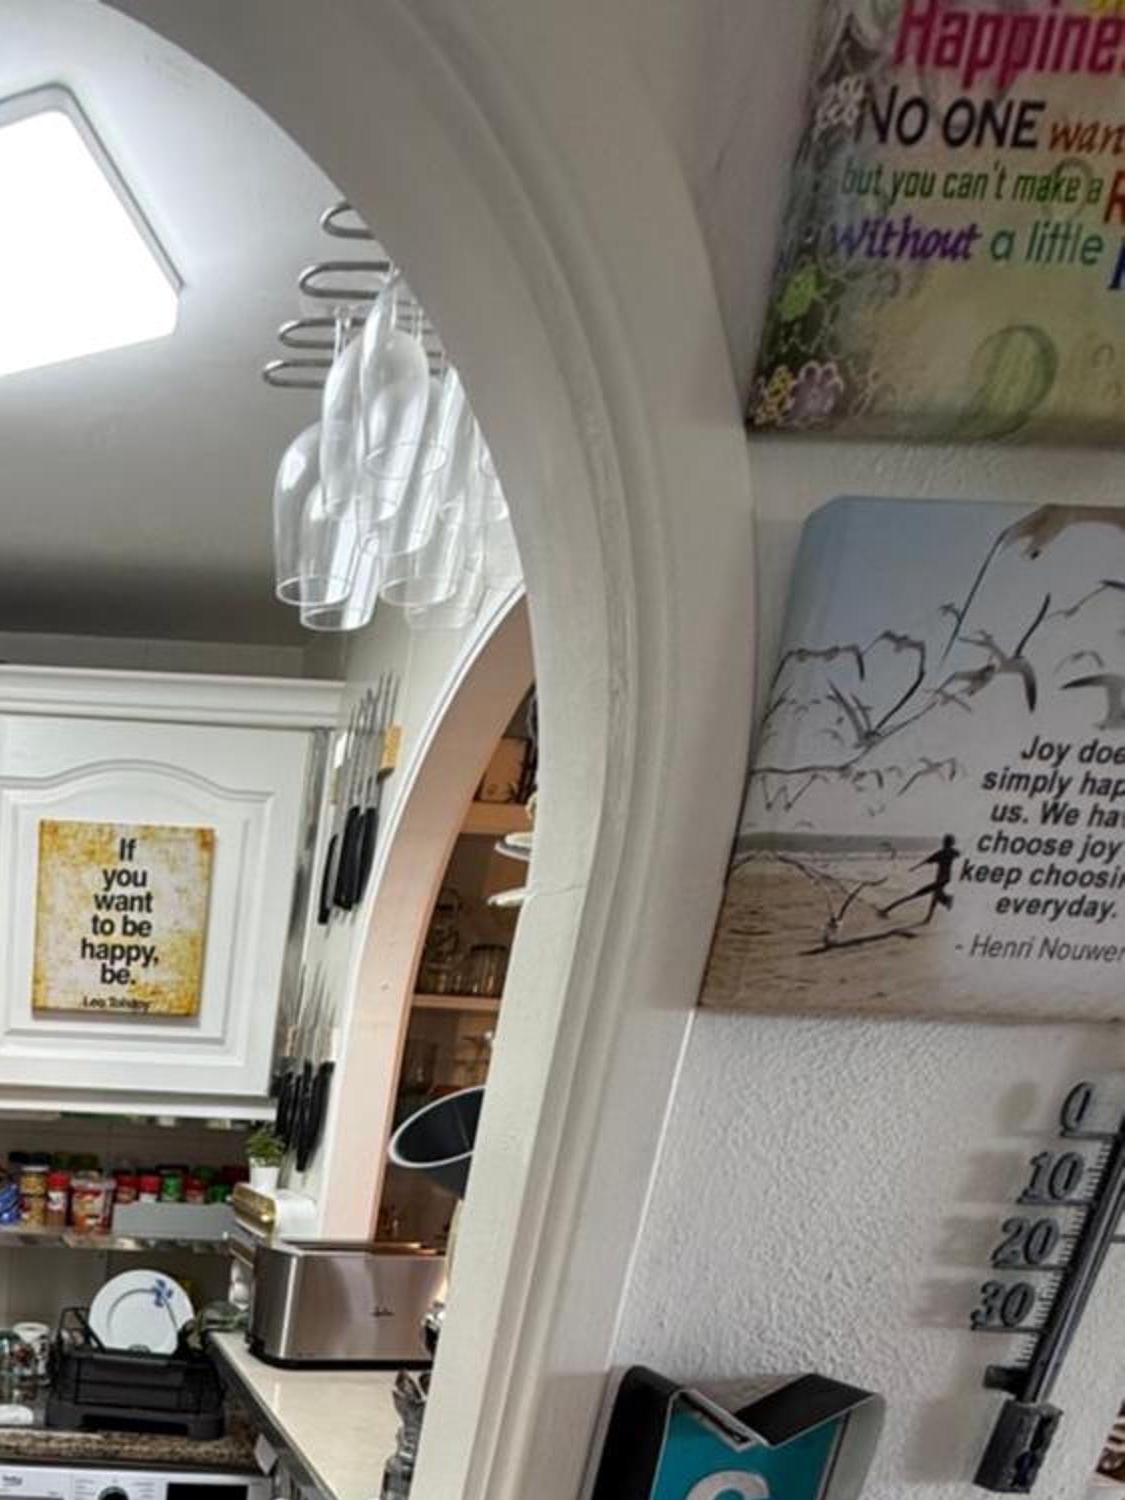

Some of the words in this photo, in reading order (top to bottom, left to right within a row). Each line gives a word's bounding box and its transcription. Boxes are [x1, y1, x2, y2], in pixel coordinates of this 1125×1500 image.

[892, 0, 1125, 89] Happine
[854, 84, 929, 147] NO
[942, 98, 1046, 150] ONE
[1049, 119, 1125, 154] wan
[841, 163, 883, 196] but
[886, 169, 935, 209] you
[942, 165, 1007, 199] can't
[1013, 172, 1080, 203] make
[1088, 178, 1104, 204] a
[990, 233, 1015, 261] a
[1025, 221, 1104, 265] little
[1021, 735, 1071, 768] Joy
[1078, 738, 1125, 765] doe
[981, 767, 1073, 799] simply
[1079, 770, 1125, 802] hap
[990, 804, 1029, 825] us.
[1040, 801, 1080, 827] We
[118, 837, 138, 862] If
[977, 830, 1074, 857] choose
[1076, 834, 1123, 865] joy
[102, 868, 148, 892] you
[959, 859, 1022, 889] keep
[93, 892, 154, 913] want
[994, 894, 1118, 924] everyday.
[91, 914, 115, 937] to
[122, 916, 152, 937] be
[80, 938, 159, 968] happy,
[968, 935, 1035, 960] Henri
[100, 963, 136, 985] be.
[1059, 1081, 1095, 1134] 0
[1021, 1151, 1085, 1201] 10
[992, 1216, 1059, 1267] 20
[971, 1280, 1035, 1328] 30
